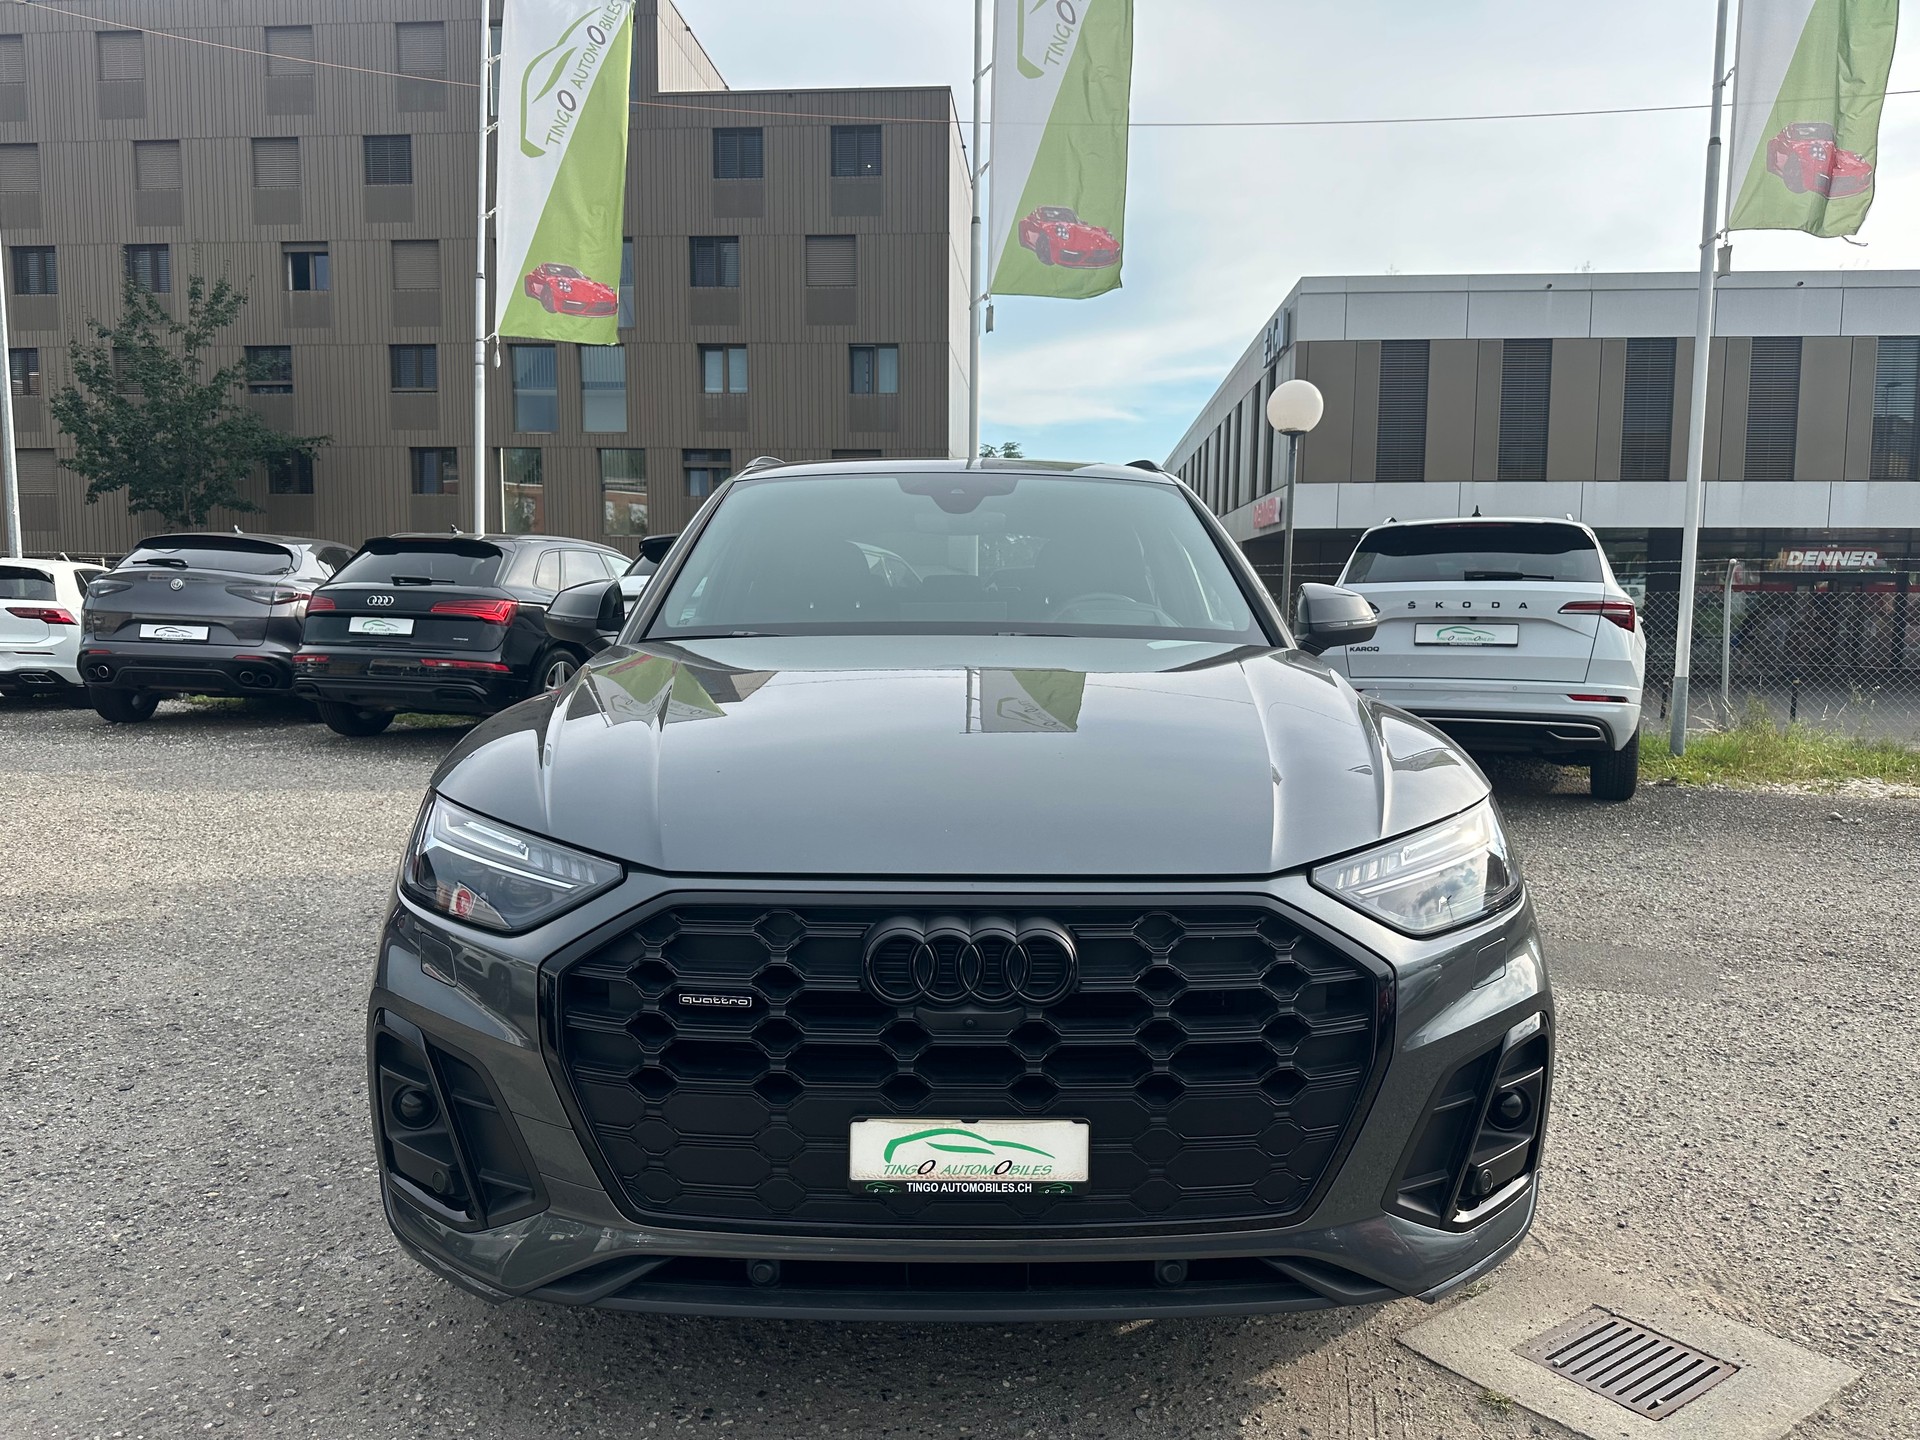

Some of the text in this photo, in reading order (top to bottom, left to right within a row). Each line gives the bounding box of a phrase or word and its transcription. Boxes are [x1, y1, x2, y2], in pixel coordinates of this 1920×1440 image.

[1044, 0, 1076, 66] TINGO
[545, 0, 622, 145] TINGO AUTOMOBILES
[1786, 551, 1878, 567] DENNER
[1407, 600, 1528, 609] ŠKODA
[681, 996, 748, 1005] quattro
[884, 1159, 1053, 1175] TINGO AUTOMOBILES
[906, 1182, 1033, 1193] TINGO AUTOMOBILES.CH
